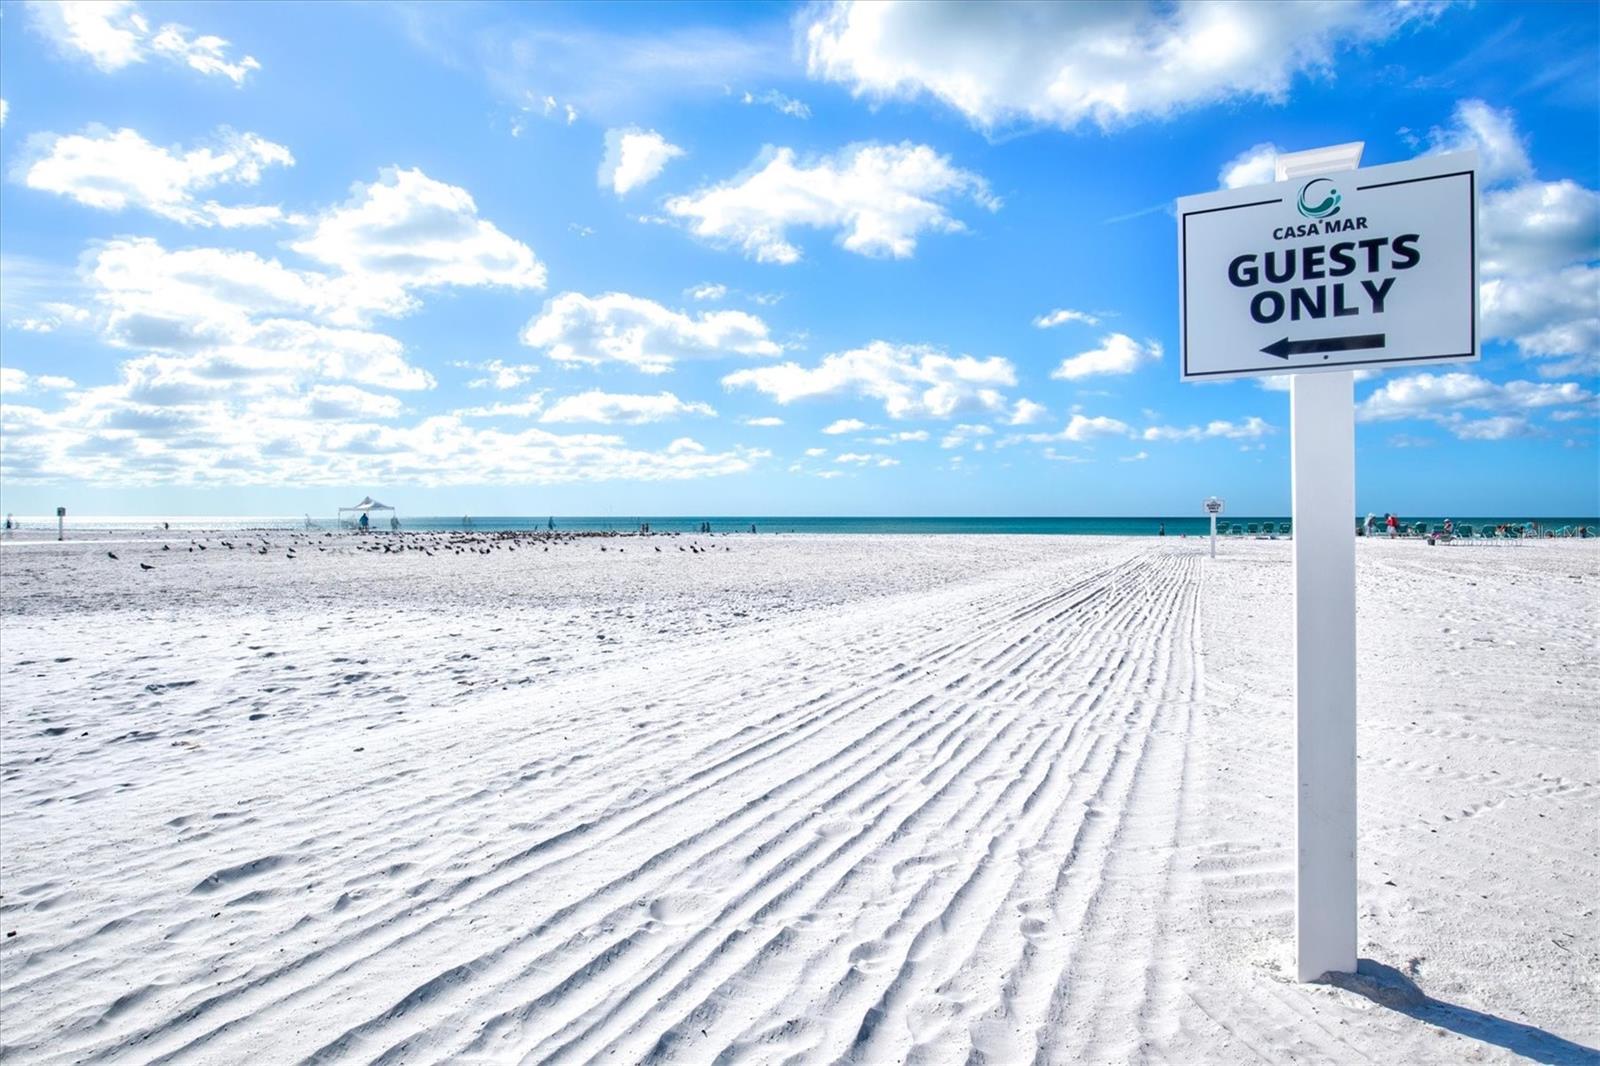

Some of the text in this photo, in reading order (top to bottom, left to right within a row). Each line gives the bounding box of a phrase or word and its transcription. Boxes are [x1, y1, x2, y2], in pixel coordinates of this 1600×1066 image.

[1272, 216, 1369, 241] CASA MAR
[1228, 233, 1421, 288] GUESTS
[1250, 277, 1397, 325] ONLY
